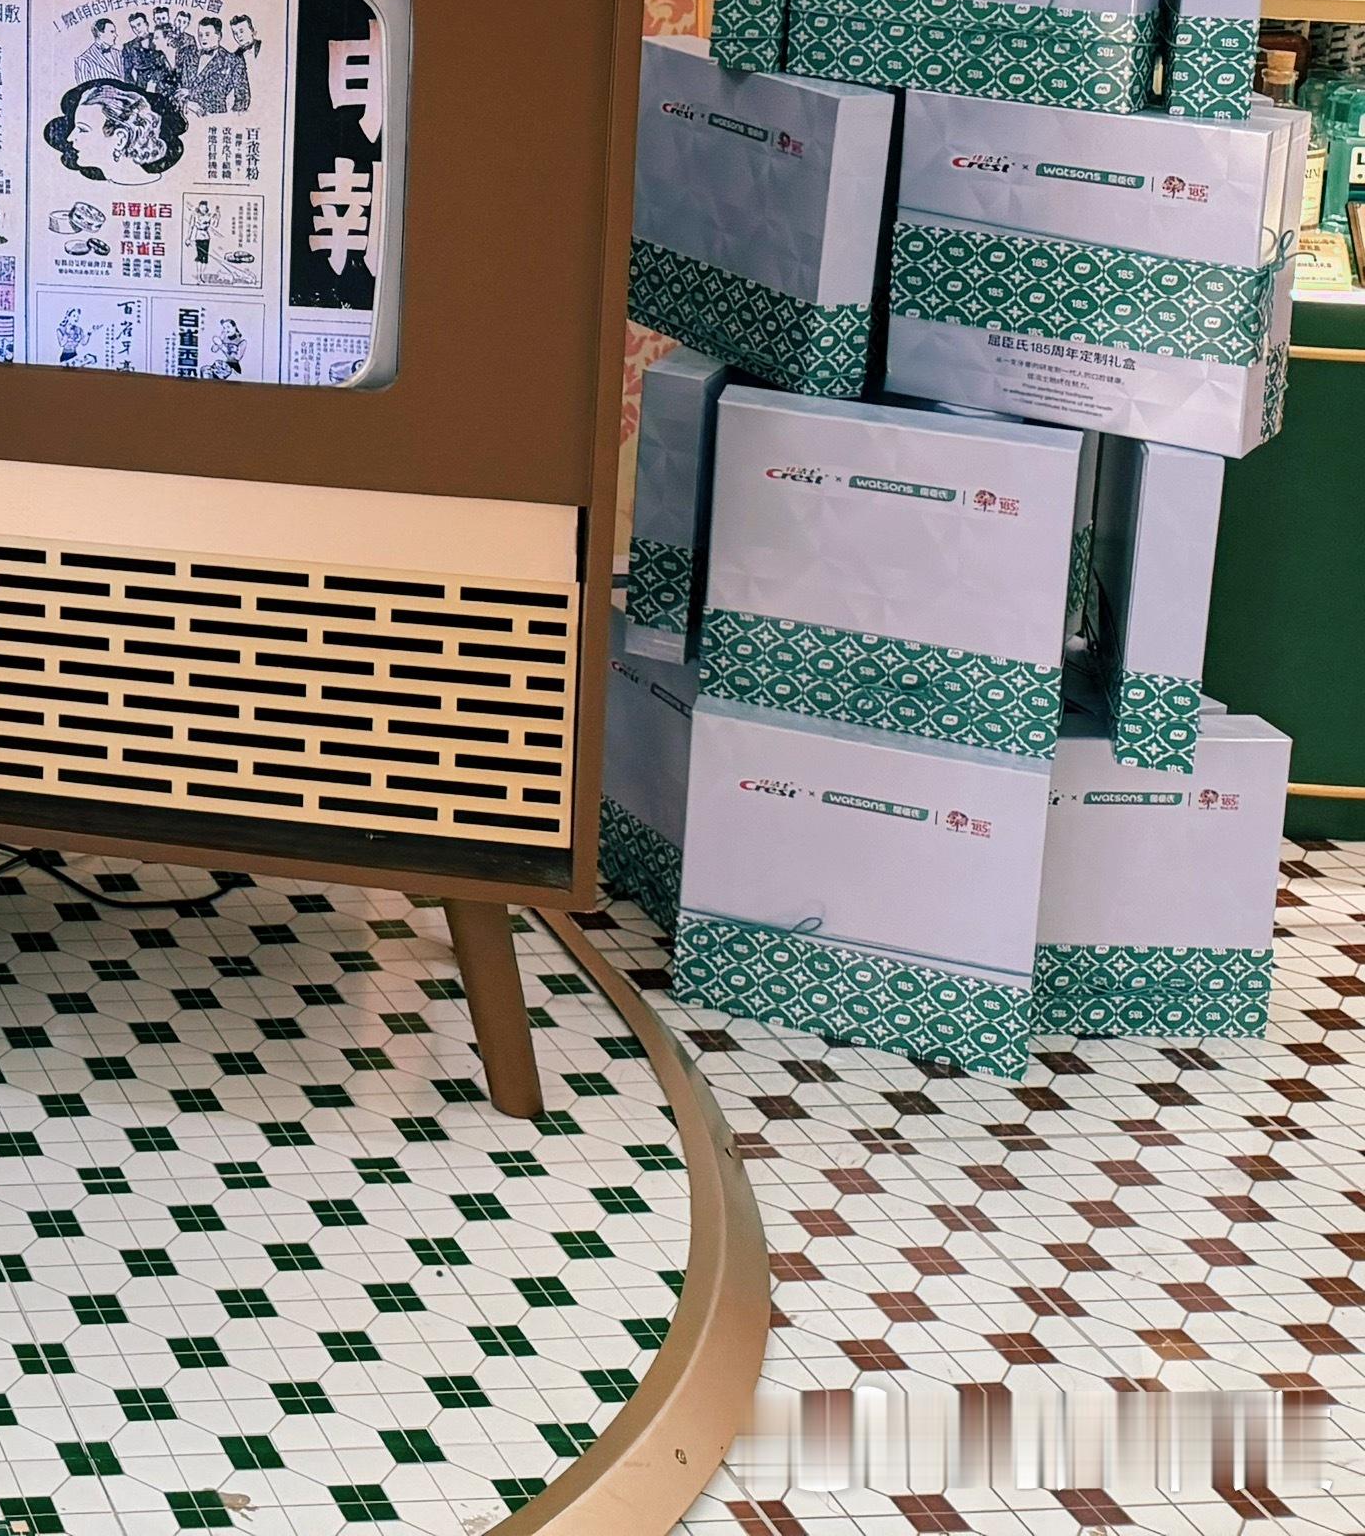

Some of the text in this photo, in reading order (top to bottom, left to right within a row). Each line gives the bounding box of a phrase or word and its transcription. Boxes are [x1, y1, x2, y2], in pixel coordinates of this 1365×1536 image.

[1220, 36, 1240, 49] 185
[952, 156, 1011, 174] Crest
[1043, 165, 1102, 182] watsons
[948, 246, 965, 258] 185
[1031, 256, 1049, 269] 185
[906, 274, 922, 286] 185
[1116, 268, 1135, 281] 185
[987, 286, 1005, 298] 185
[1205, 280, 1225, 294] 185
[1071, 297, 1089, 311] 185
[1157, 310, 1177, 323] 185
[987, 333, 1137, 371] 屈臣氏185周年定制礼盒
[766, 467, 824, 485] Crest
[855, 477, 914, 495] watsons
[1173, 694, 1192, 707] 185
[1124, 723, 1144, 736] 185
[739, 779, 797, 799] Crest
[829, 792, 887, 812] watsons
[1090, 793, 1144, 803] watsons
[770, 983, 788, 996] 185
[897, 980, 914, 993] 185
[982, 999, 1002, 1012] 185
[935, 1023, 955, 1036] 185
